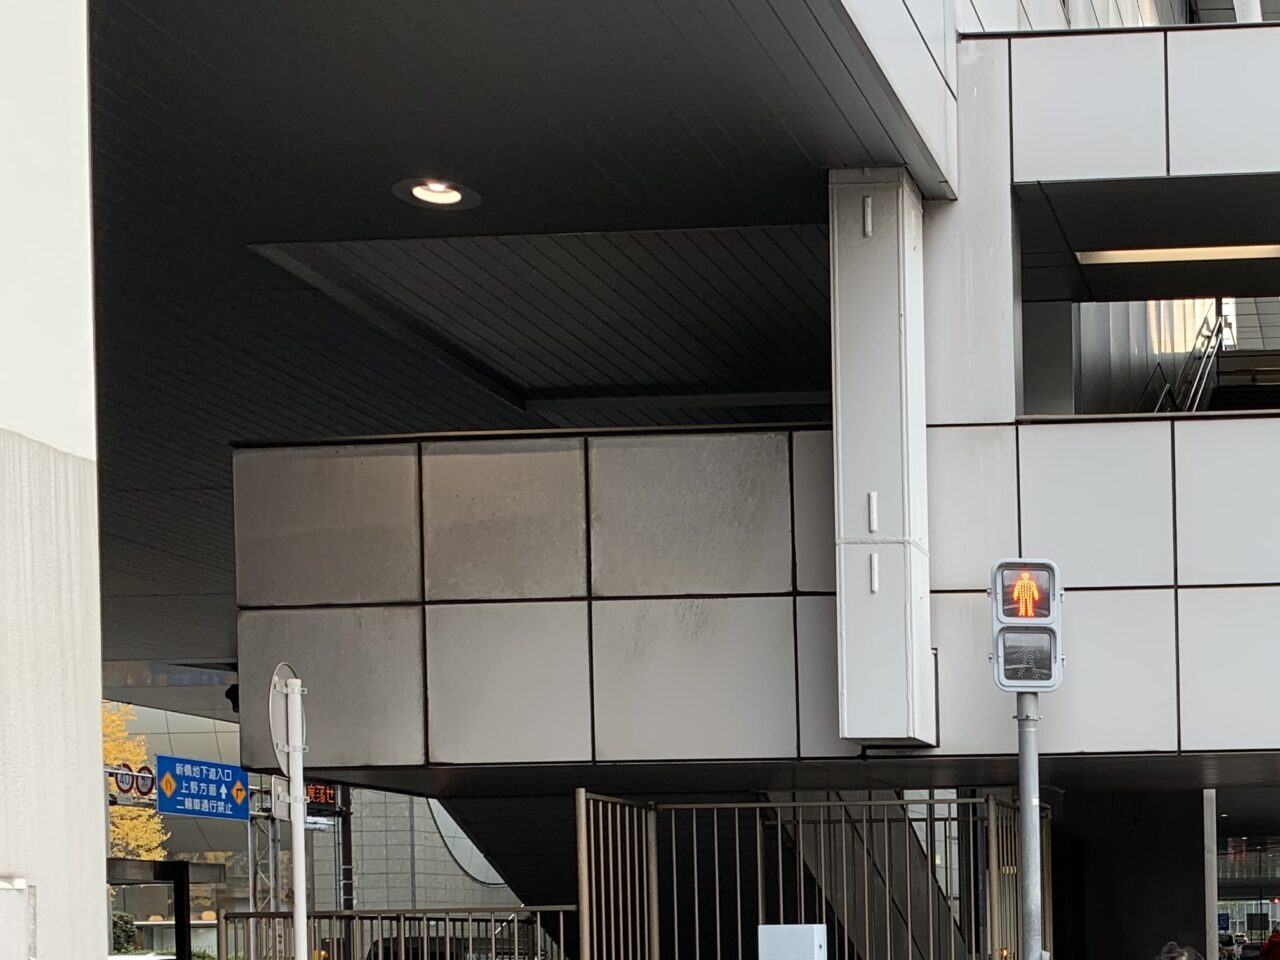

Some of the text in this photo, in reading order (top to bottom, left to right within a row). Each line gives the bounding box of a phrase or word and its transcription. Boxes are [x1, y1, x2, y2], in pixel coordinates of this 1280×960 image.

[175, 763, 232, 781] 新橋地下道入口
[180, 781, 217, 796] 上野方面
[176, 796, 233, 814] 二輪車通行禁止
